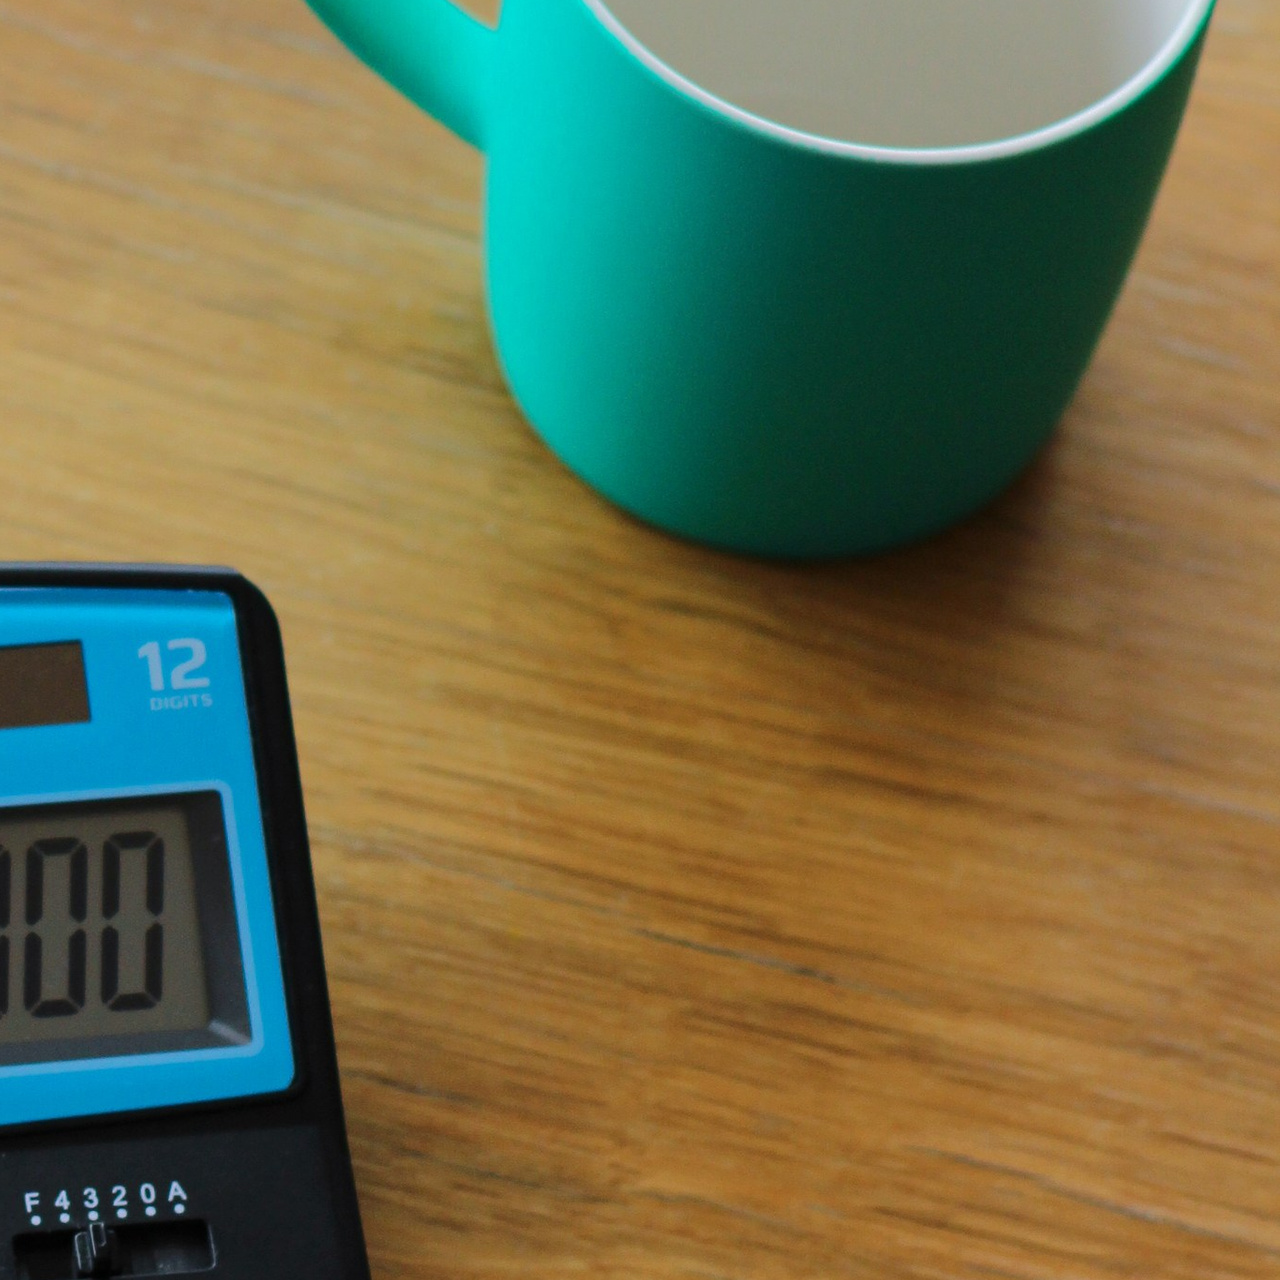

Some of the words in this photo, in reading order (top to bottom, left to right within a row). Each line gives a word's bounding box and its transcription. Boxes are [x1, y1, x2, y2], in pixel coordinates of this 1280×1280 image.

[138, 637, 210, 691] 12
[149, 693, 213, 711] DIGITS
[24, 1192, 40, 1213] F
[54, 1189, 71, 1210] 4
[83, 1187, 99, 1209] 3
[111, 1185, 128, 1207] 2
[140, 1183, 156, 1204] 0
[167, 1181, 188, 1202] A
